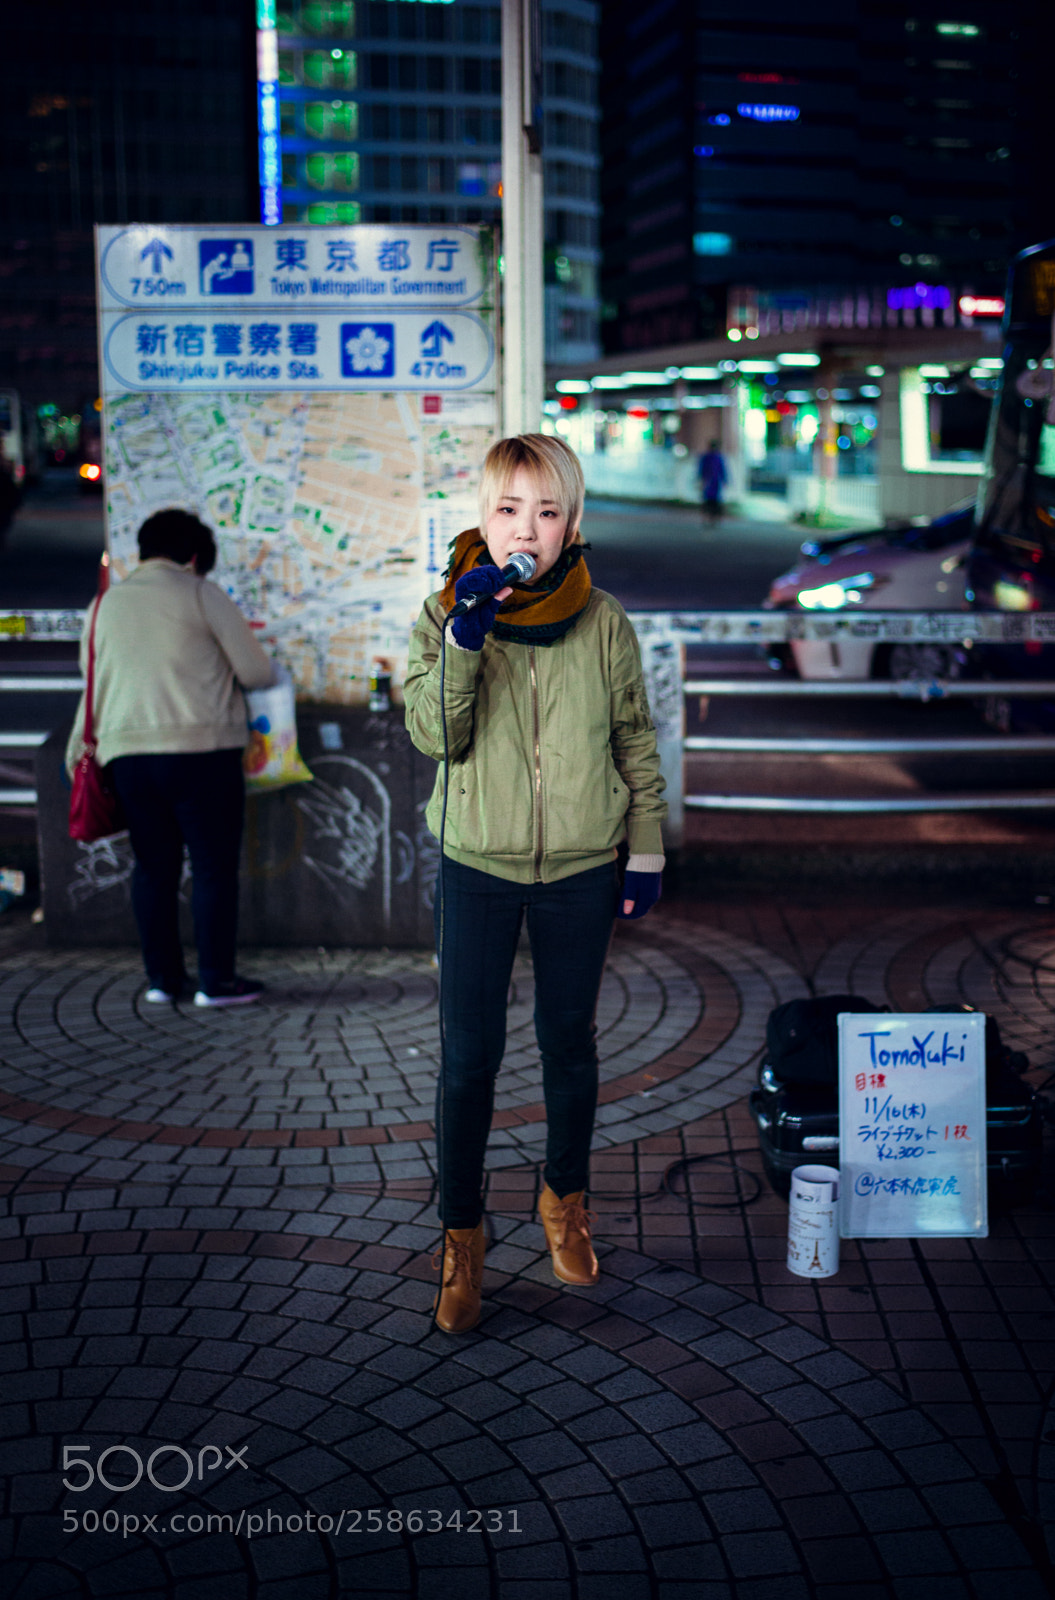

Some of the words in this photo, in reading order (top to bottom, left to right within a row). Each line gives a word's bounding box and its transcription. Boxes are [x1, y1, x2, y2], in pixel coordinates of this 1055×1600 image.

[273, 238, 462, 273] 東京都庁
[130, 277, 186, 297] 750m
[270, 277, 308, 299] Tokyo
[309, 277, 386, 298] Metropolitan
[389, 277, 468, 296] Government
[136, 322, 319, 357] 新宿警察署
[138, 361, 219, 384] Shinjuku
[224, 361, 282, 381] Police
[287, 361, 324, 381] Sta.
[409, 361, 467, 380] 470m
[857, 1030, 968, 1070] TomoYuki
